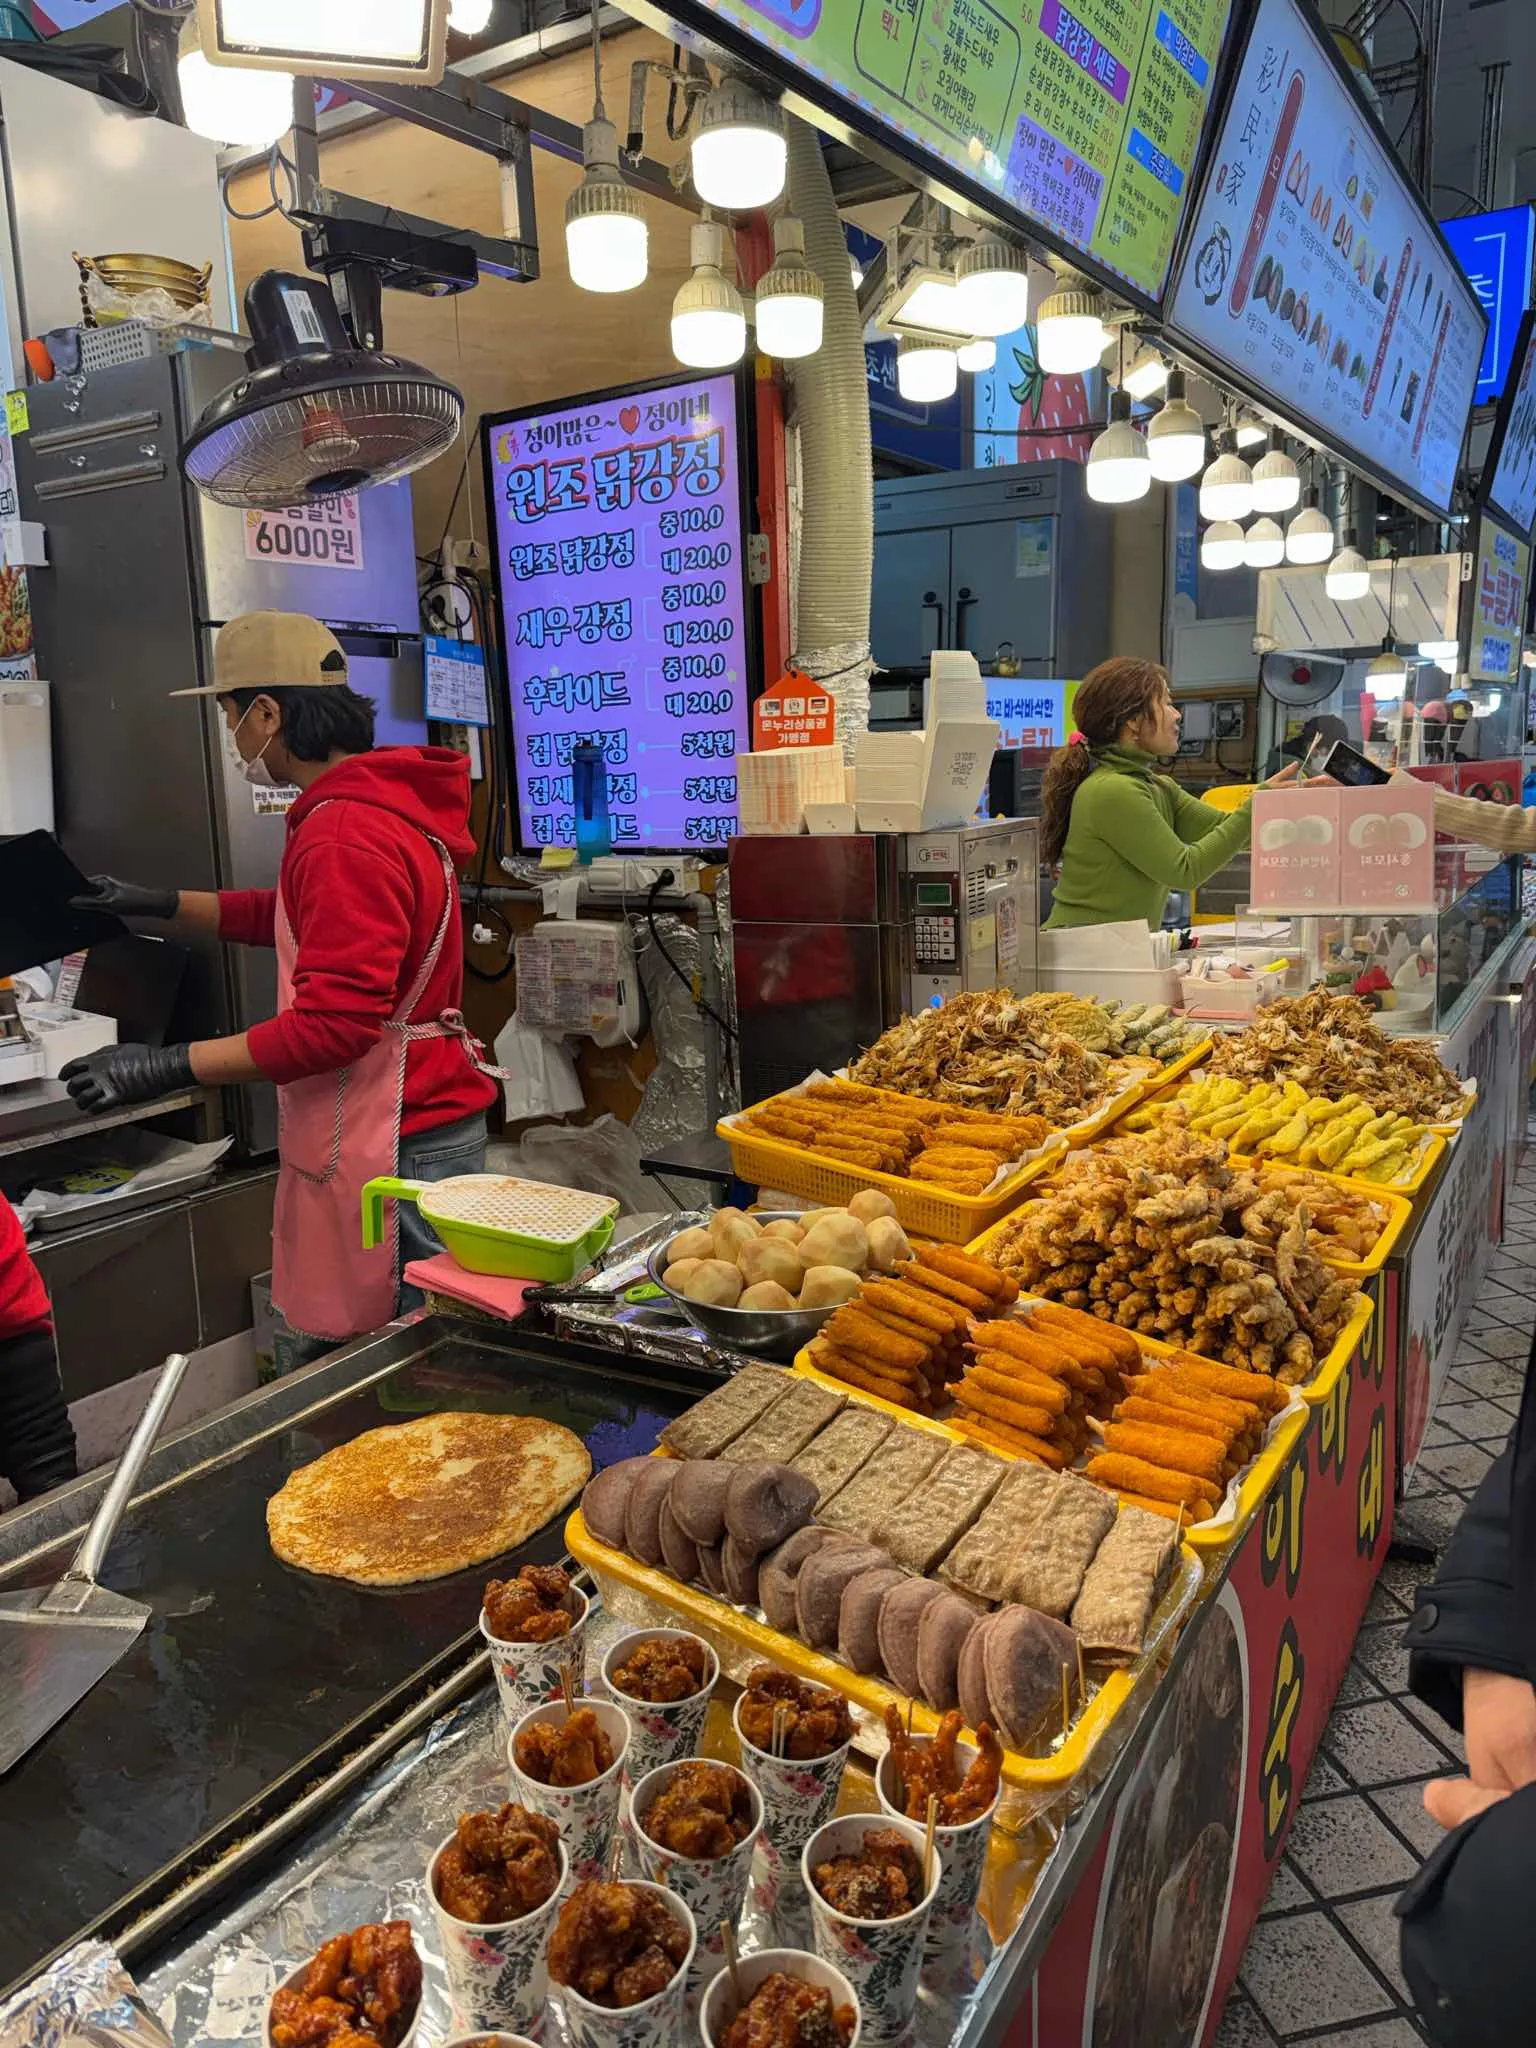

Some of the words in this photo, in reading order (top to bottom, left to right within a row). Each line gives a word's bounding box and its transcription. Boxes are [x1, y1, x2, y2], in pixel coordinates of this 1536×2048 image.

[1054, 6, 1095, 70] 닭강정
[1093, 46, 1117, 88] 세트
[644, 392, 711, 432] 정이네
[506, 457, 590, 524] 원조
[592, 428, 725, 513] 닭강정
[659, 511, 679, 538] 중
[681, 504, 724, 534] 10.0
[256, 521, 356, 565] 6000원
[509, 543, 558, 580] 원조
[558, 528, 635, 576] 닭강정
[661, 548, 682, 575] 대
[684, 542, 732, 570] 20.0
[662, 585, 681, 612] 중
[683, 580, 727, 608] 10.0
[516, 606, 571, 648] 새우
[573, 598, 633, 645] 강정
[664, 622, 683, 648] 대
[687, 618, 734, 644] 20.0
[662, 656, 681, 682] 중
[684, 653, 726, 679] 10.0
[523, 670, 631, 716] 후라이드
[664, 692, 684, 718] 대
[687, 689, 733, 715] 20.0
[1003, 697, 1054, 719] 바삭바삭한
[762, 717, 827, 732] 온누리상품권
[778, 732, 810, 744] 가맹점
[527, 732, 550, 767] 컵
[681, 729, 735, 758] 5천원
[528, 775, 550, 806] 컵
[684, 775, 738, 804] 5천원
[532, 814, 553, 844] 컵
[685, 816, 738, 844] 5천원
